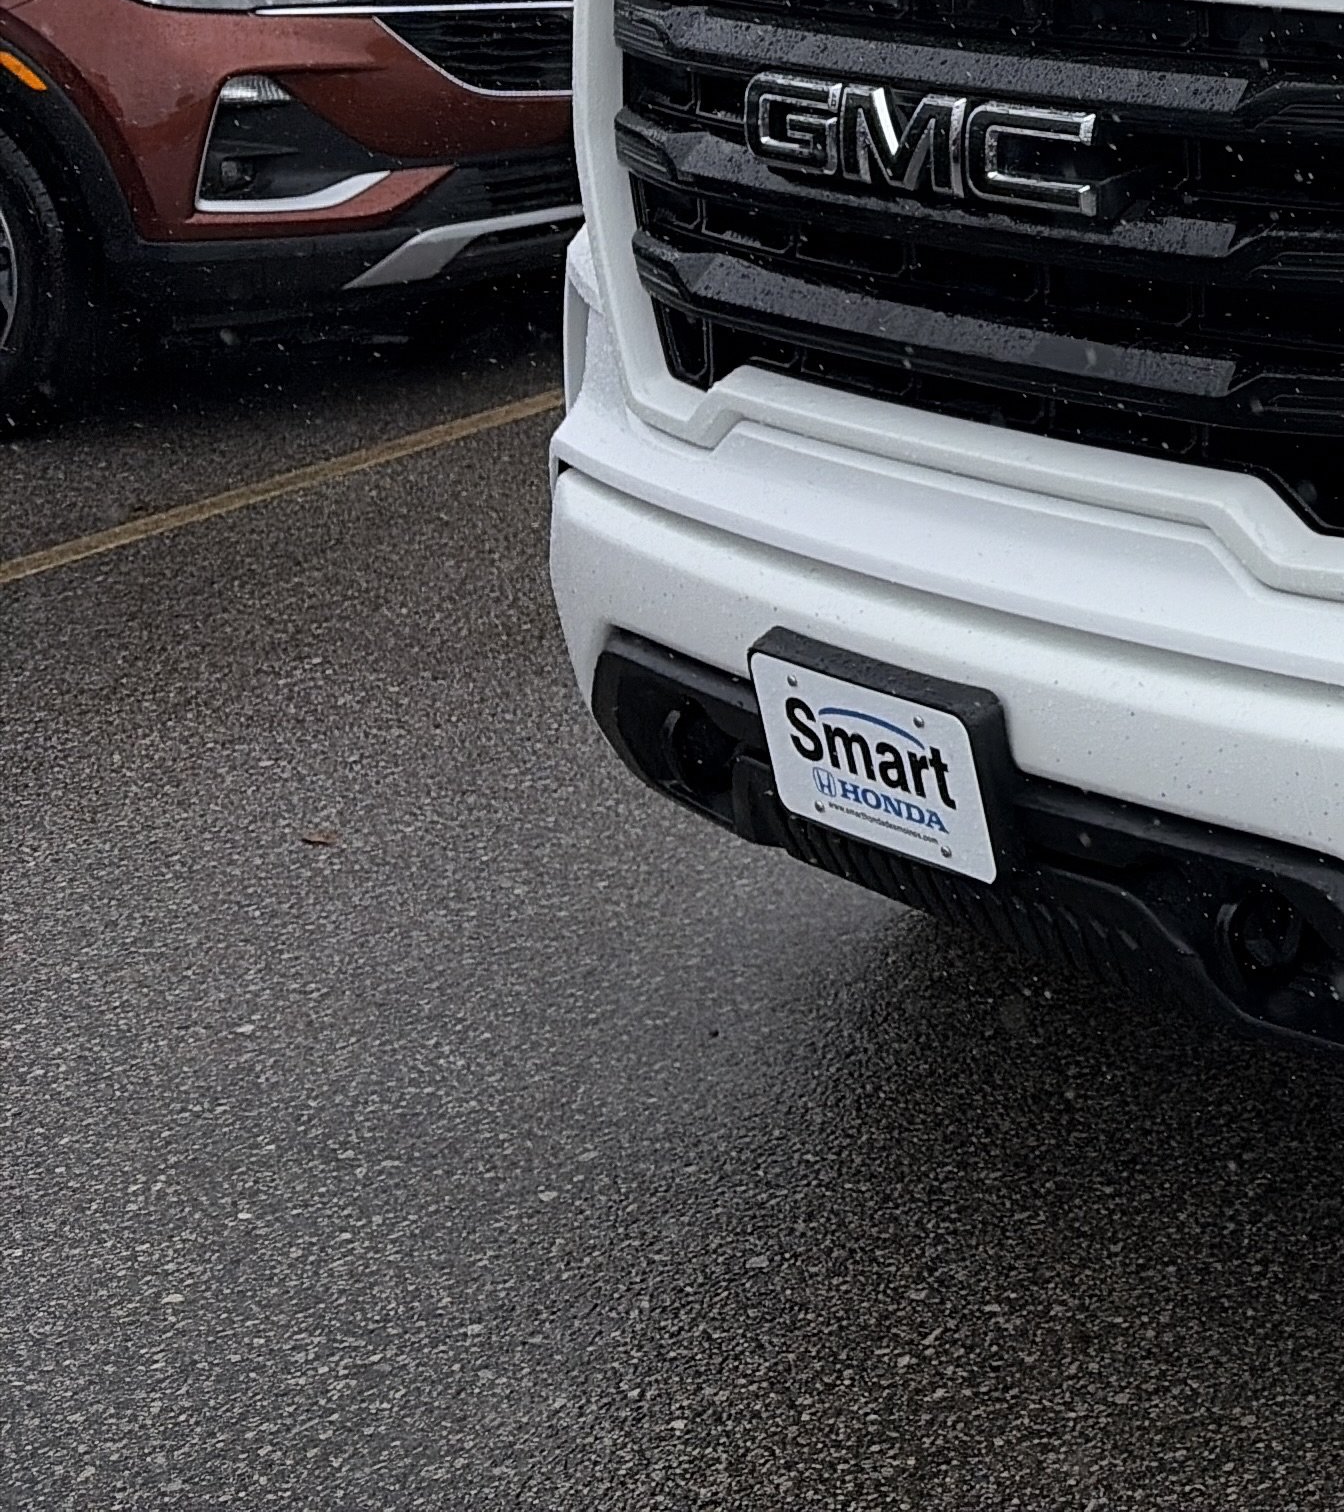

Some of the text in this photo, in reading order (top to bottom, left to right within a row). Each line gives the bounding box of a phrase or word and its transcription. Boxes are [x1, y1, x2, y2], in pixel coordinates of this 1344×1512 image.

[744, 71, 1097, 217] GMC
[785, 697, 957, 810] Smart
[837, 779, 950, 834] HONDA
